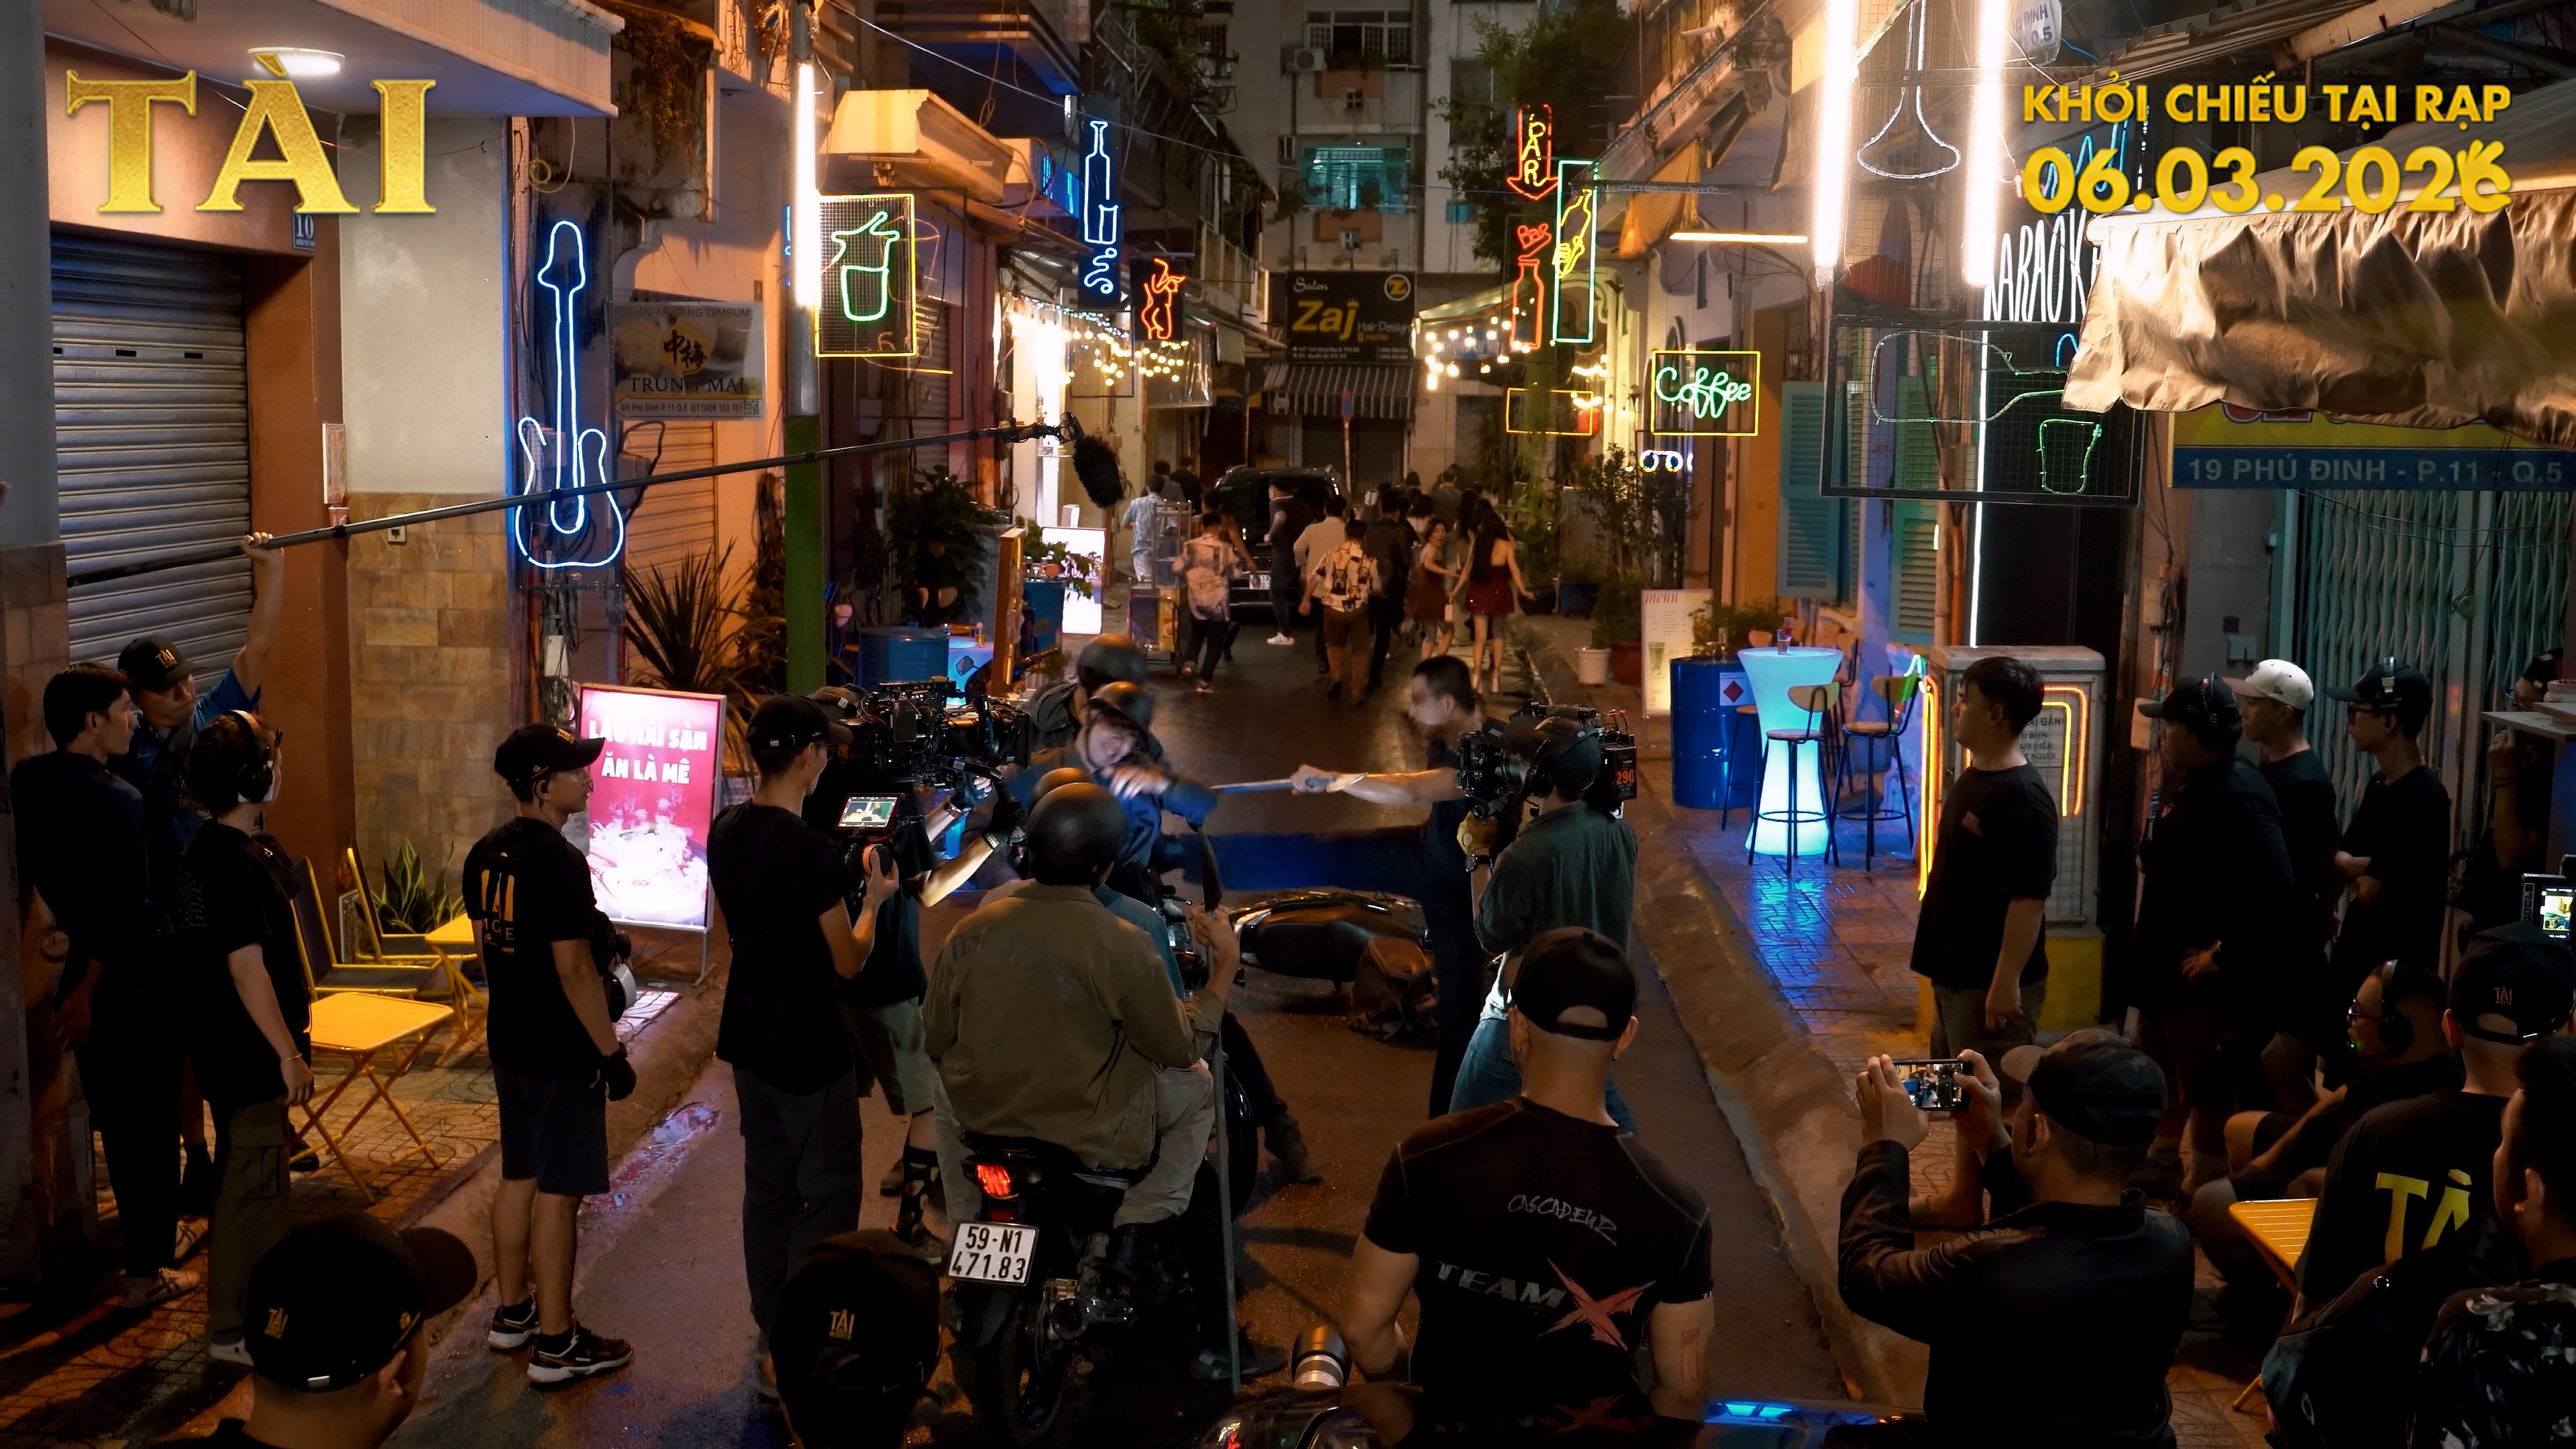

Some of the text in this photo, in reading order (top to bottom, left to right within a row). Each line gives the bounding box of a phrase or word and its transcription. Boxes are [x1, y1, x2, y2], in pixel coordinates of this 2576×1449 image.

[295, 214, 314, 239] 10
[1293, 277, 1329, 292] Salon
[1292, 299, 1359, 341] Zaj
[1357, 321, 1377, 333] Hair
[629, 377, 745, 392] TRUNG MAI
[1656, 366, 1752, 419] Coffee
[2189, 458, 2222, 480] 19
[2233, 453, 2297, 481] PHÚ
[2418, 460, 2478, 482] P.11
[2512, 461, 2562, 483] Q.5
[1646, 593, 1679, 604] menu
[601, 751, 690, 784] ĂN LÀ MÊ
[1616, 770, 1634, 786] 290
[952, 1251, 1026, 1281] 471.83
[1436, 1260, 1567, 1309] TEAM
